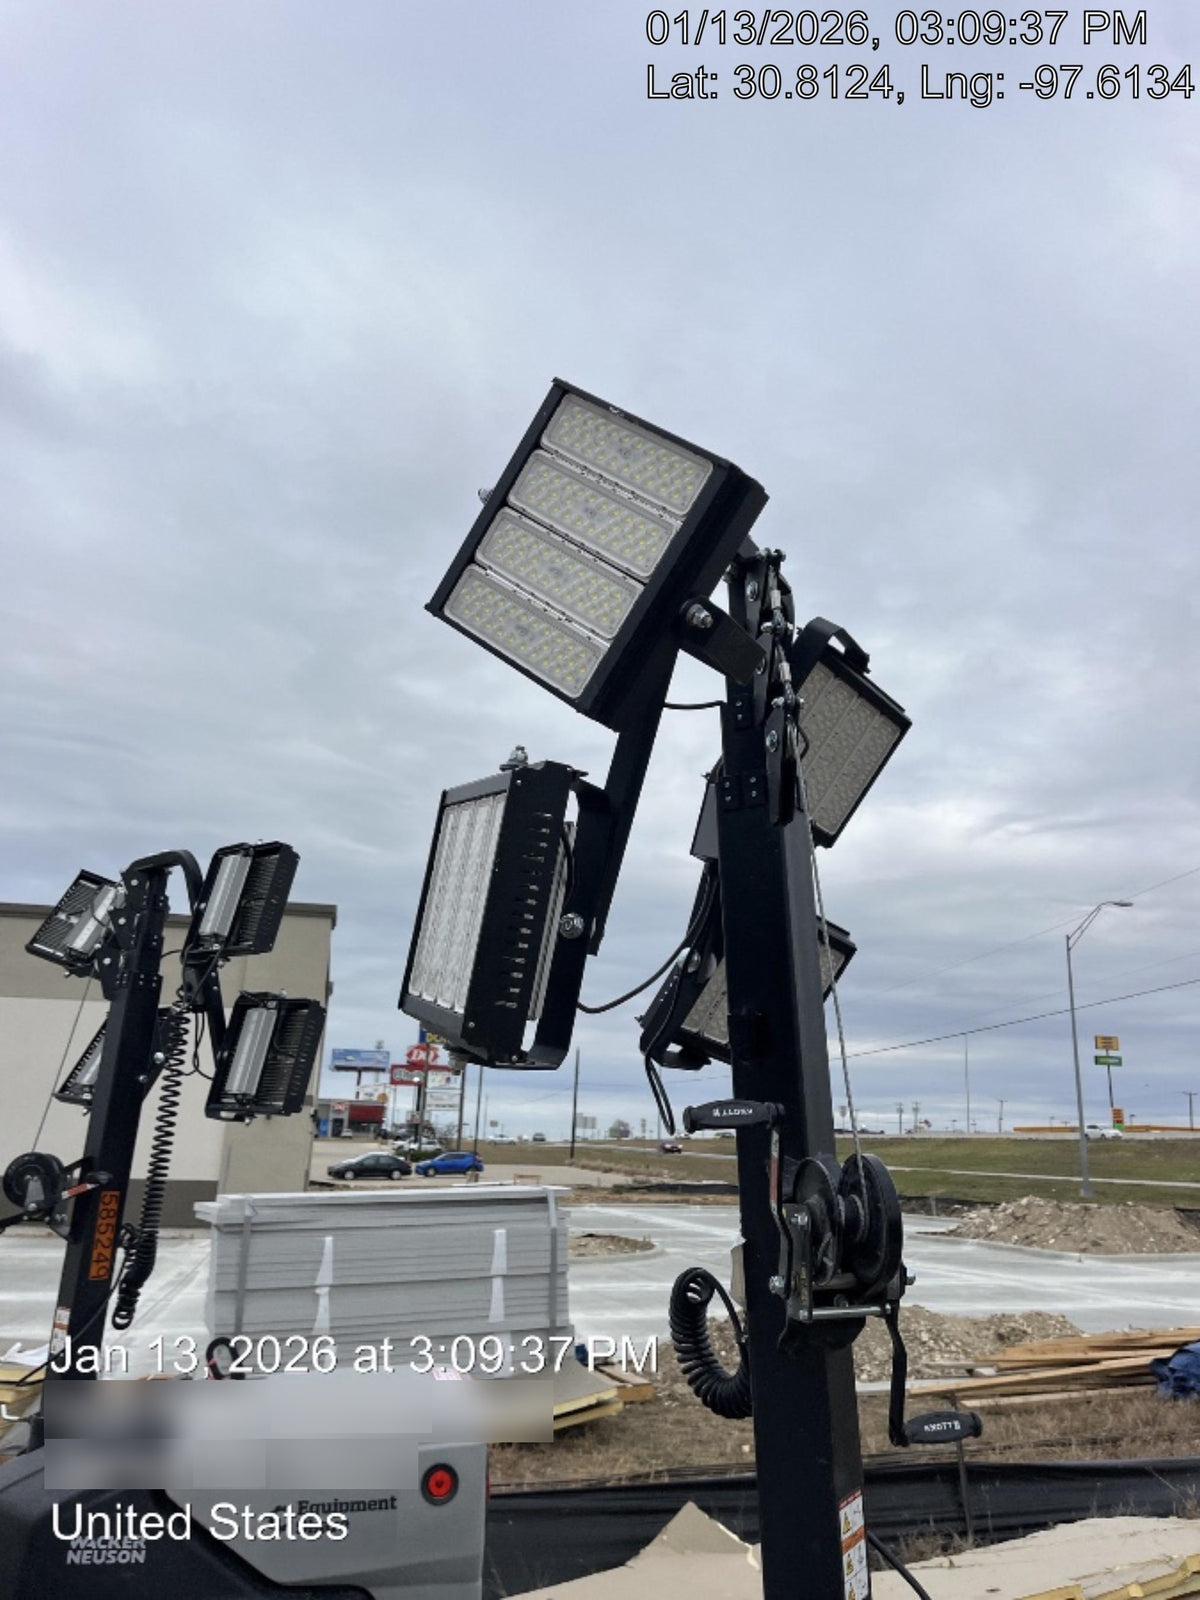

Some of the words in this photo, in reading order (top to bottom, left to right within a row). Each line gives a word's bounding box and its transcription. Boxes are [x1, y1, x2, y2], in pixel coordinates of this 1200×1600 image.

[91, 1192, 120, 1280] 585249
[298, 1495, 398, 1516] Equipment
[66, 1549, 147, 1564] NEUSON
